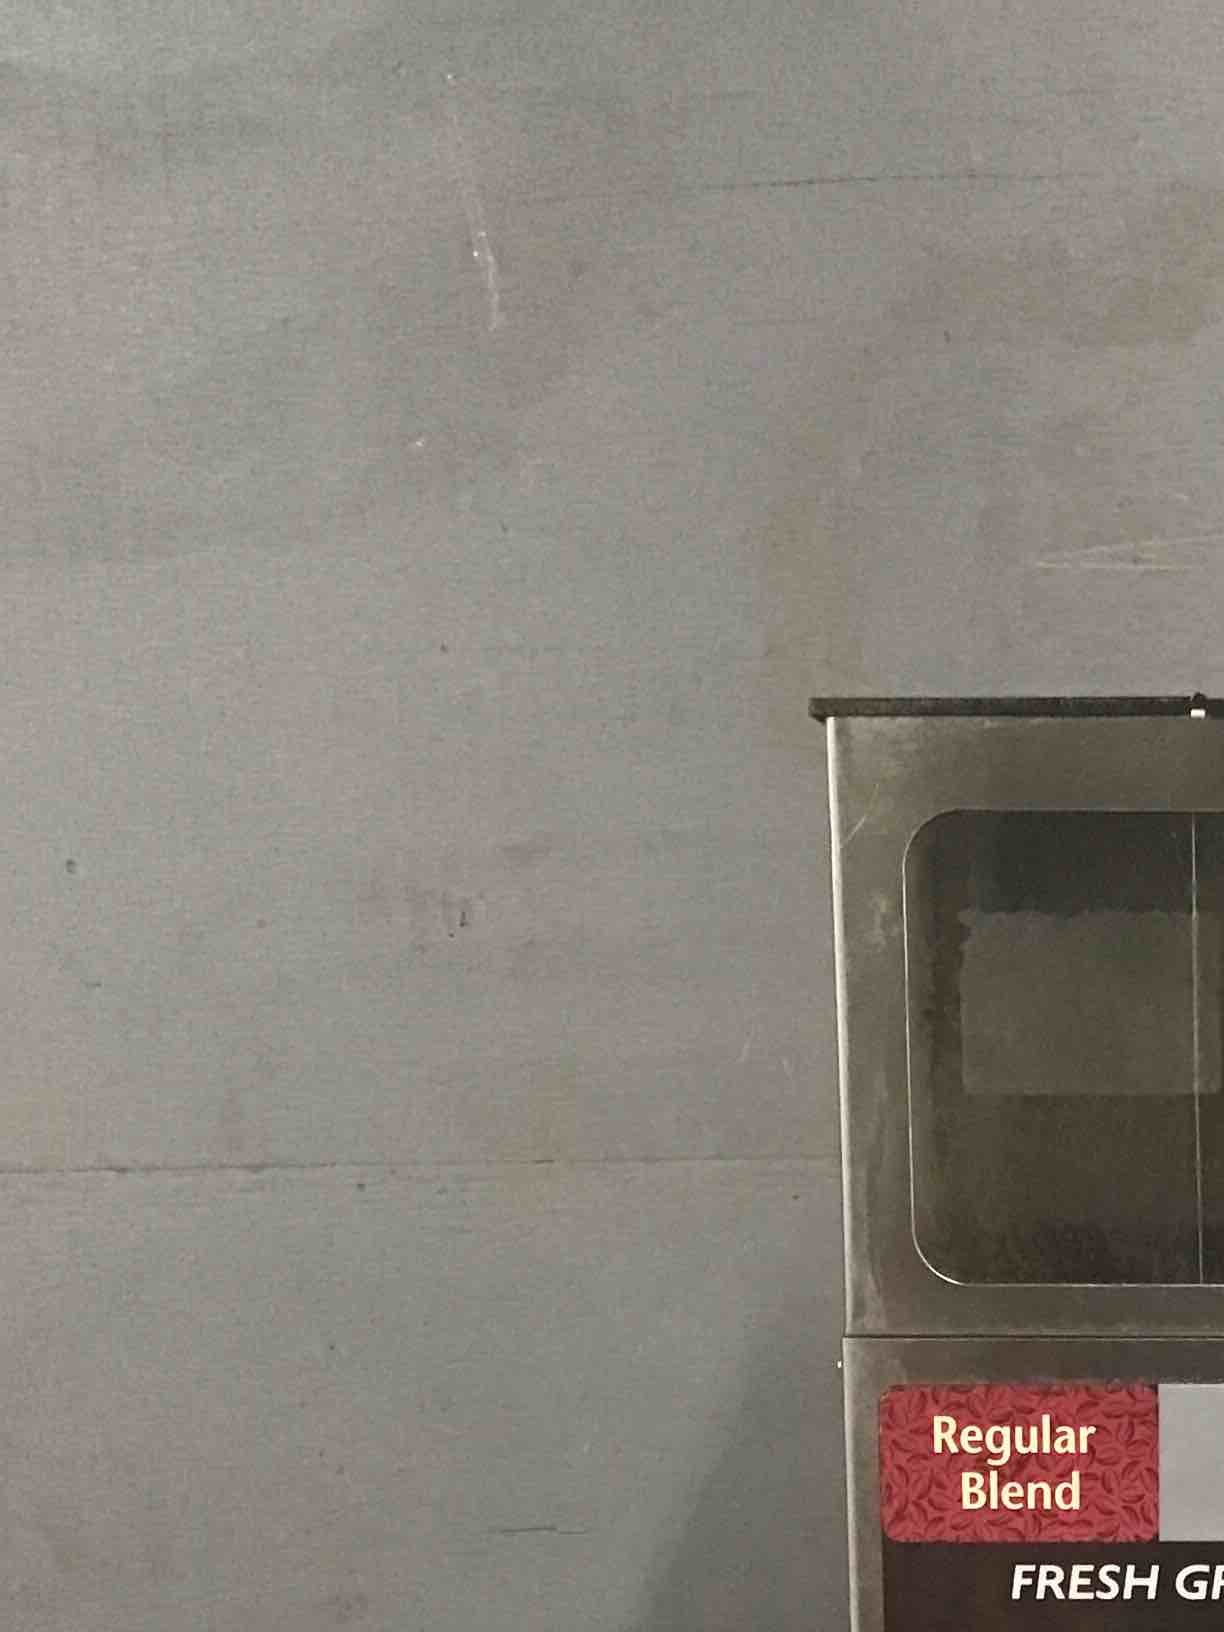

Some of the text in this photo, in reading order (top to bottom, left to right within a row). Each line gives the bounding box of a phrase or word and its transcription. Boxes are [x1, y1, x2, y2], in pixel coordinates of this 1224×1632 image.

[931, 1414, 1096, 1466] Regular
[960, 1471, 1081, 1511] Blend
[1010, 1564, 1160, 1601] FRESH
